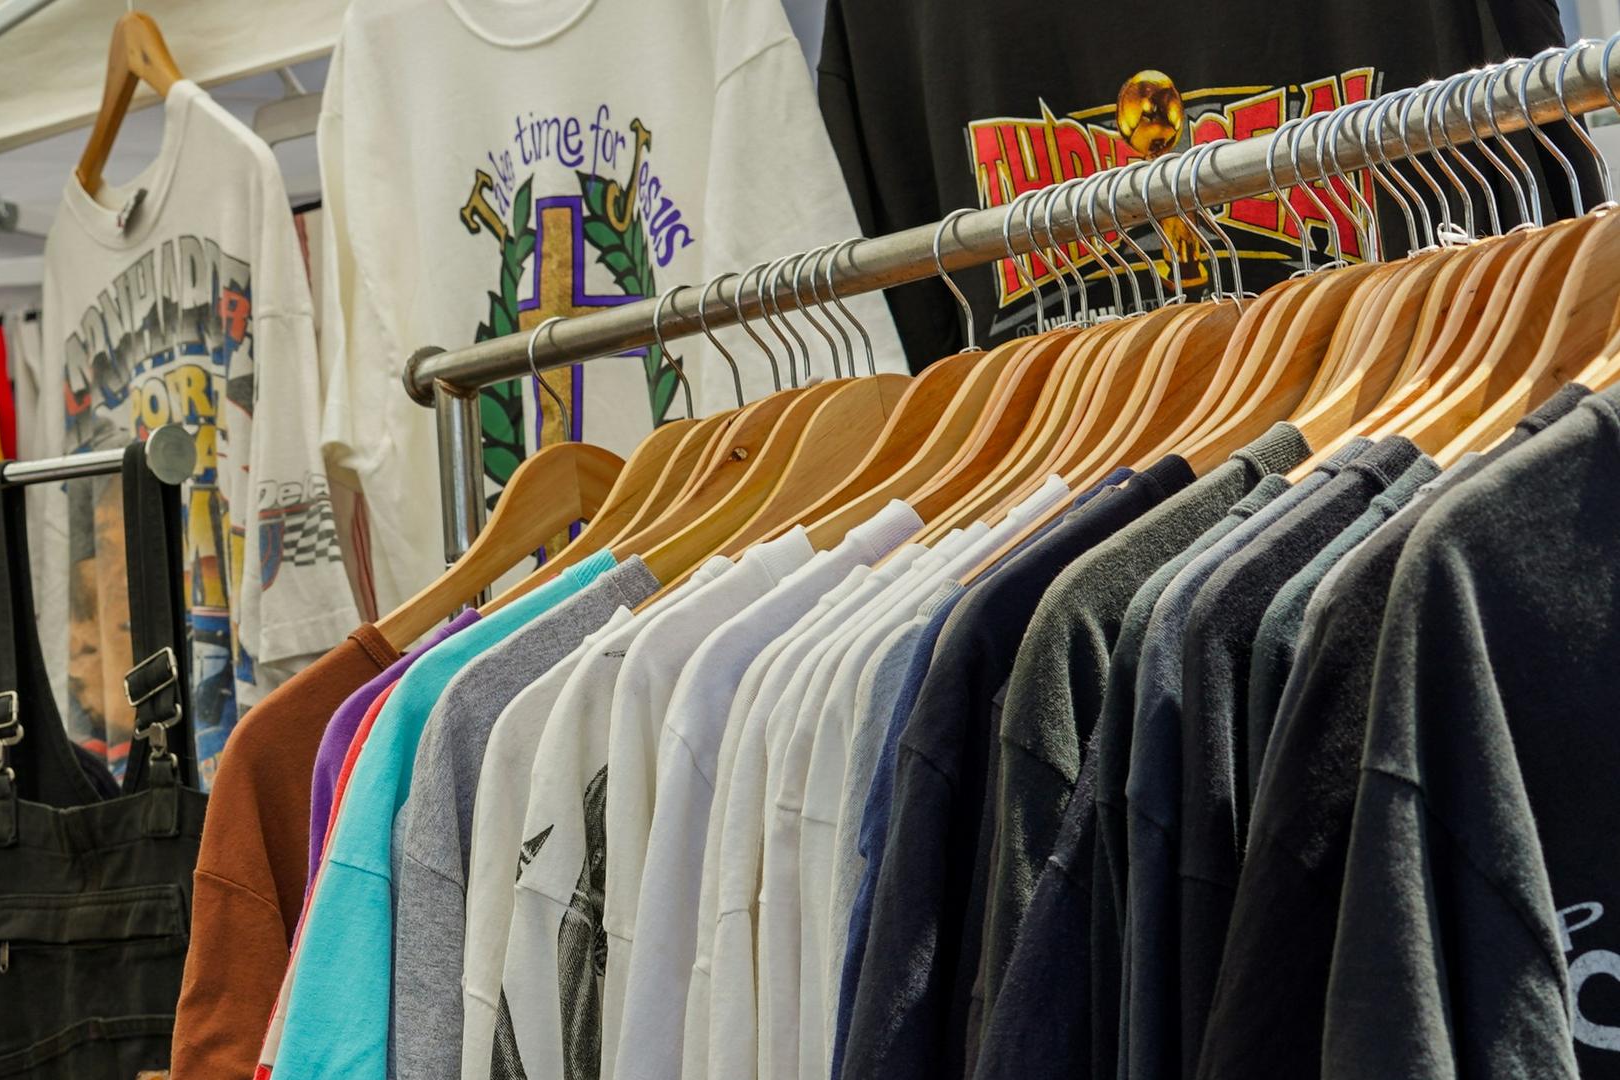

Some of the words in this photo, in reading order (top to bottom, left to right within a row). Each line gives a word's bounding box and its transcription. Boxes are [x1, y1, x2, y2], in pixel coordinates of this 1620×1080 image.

[515, 112, 585, 168] time
[589, 104, 626, 196] for
[605, 117, 696, 268] Jesus
